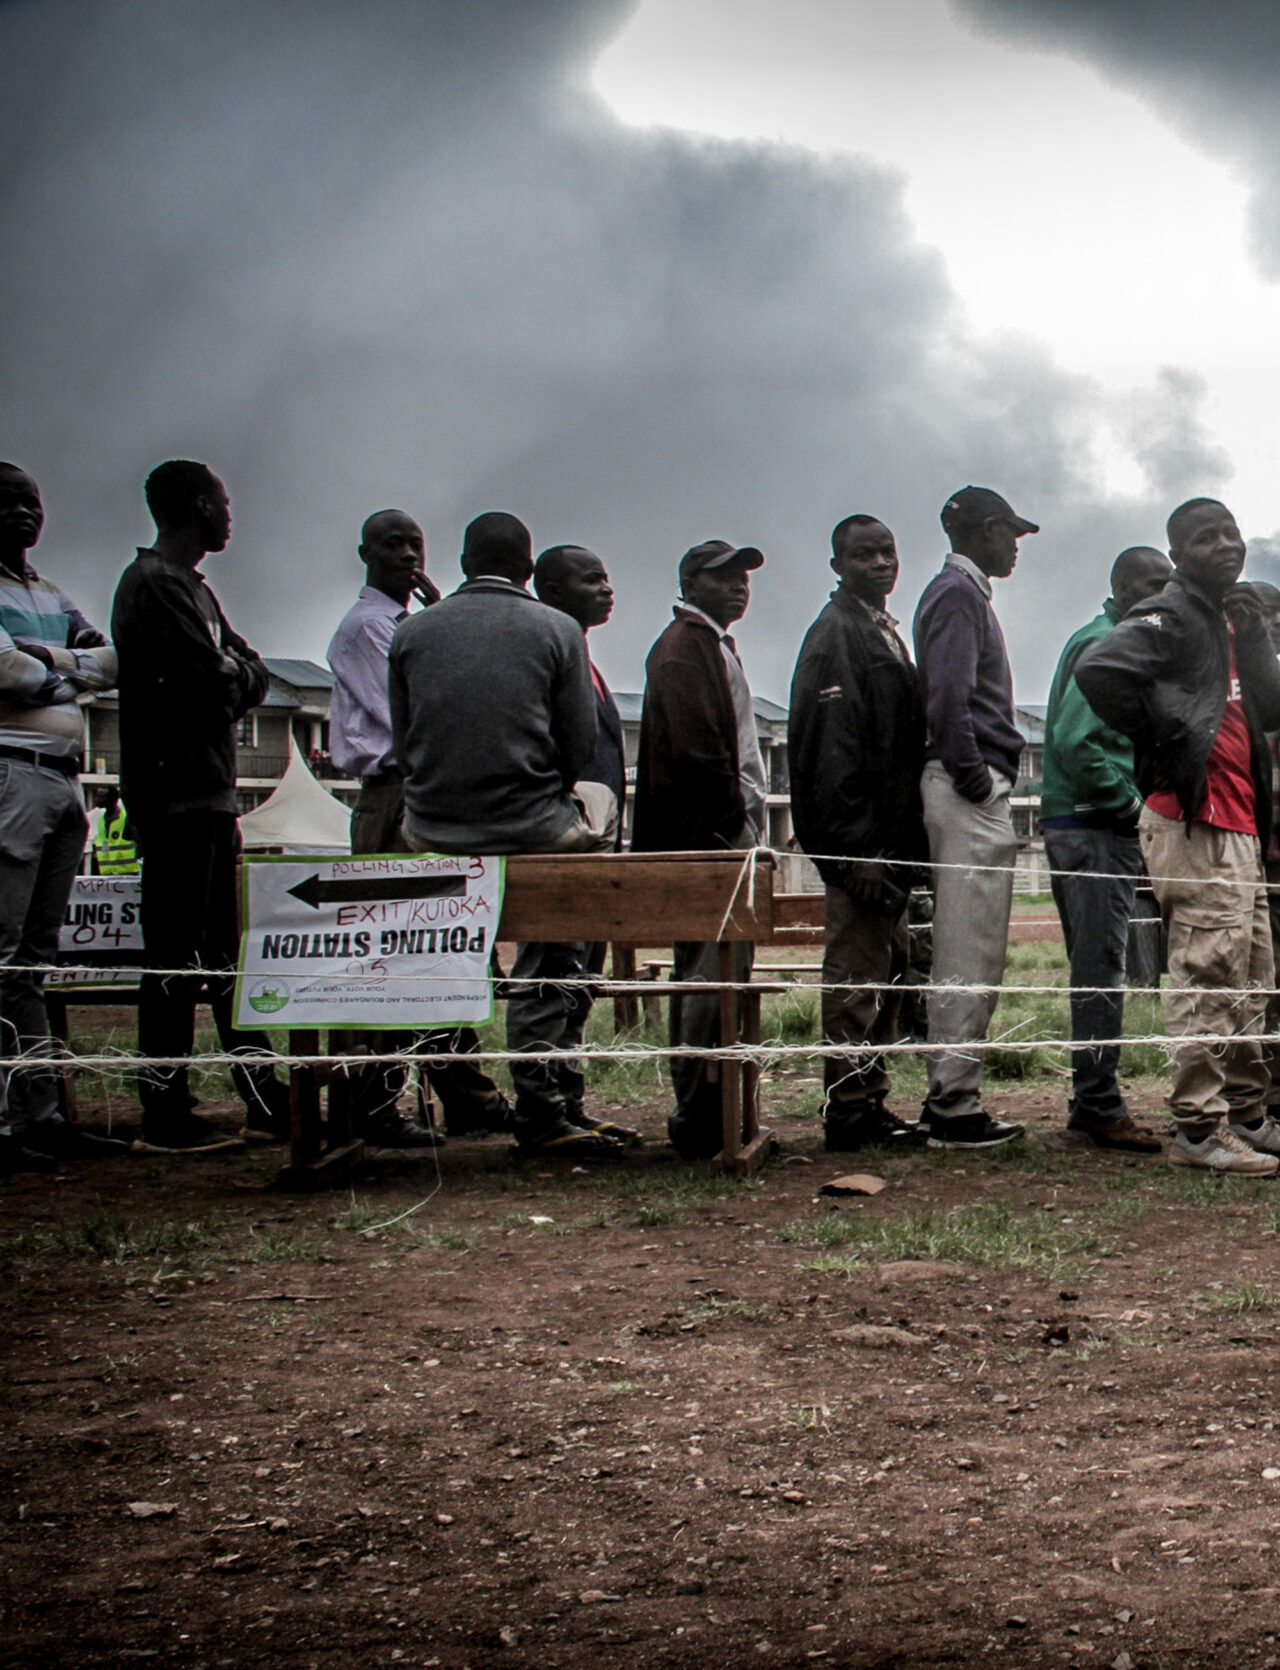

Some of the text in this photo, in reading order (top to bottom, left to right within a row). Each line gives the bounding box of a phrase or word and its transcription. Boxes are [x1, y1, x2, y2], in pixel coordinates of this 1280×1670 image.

[332, 856, 485, 879] POLLING STATION 3
[63, 902, 113, 926] LING
[72, 925, 132, 947] 04
[262, 926, 486, 959] POLLING STATION
